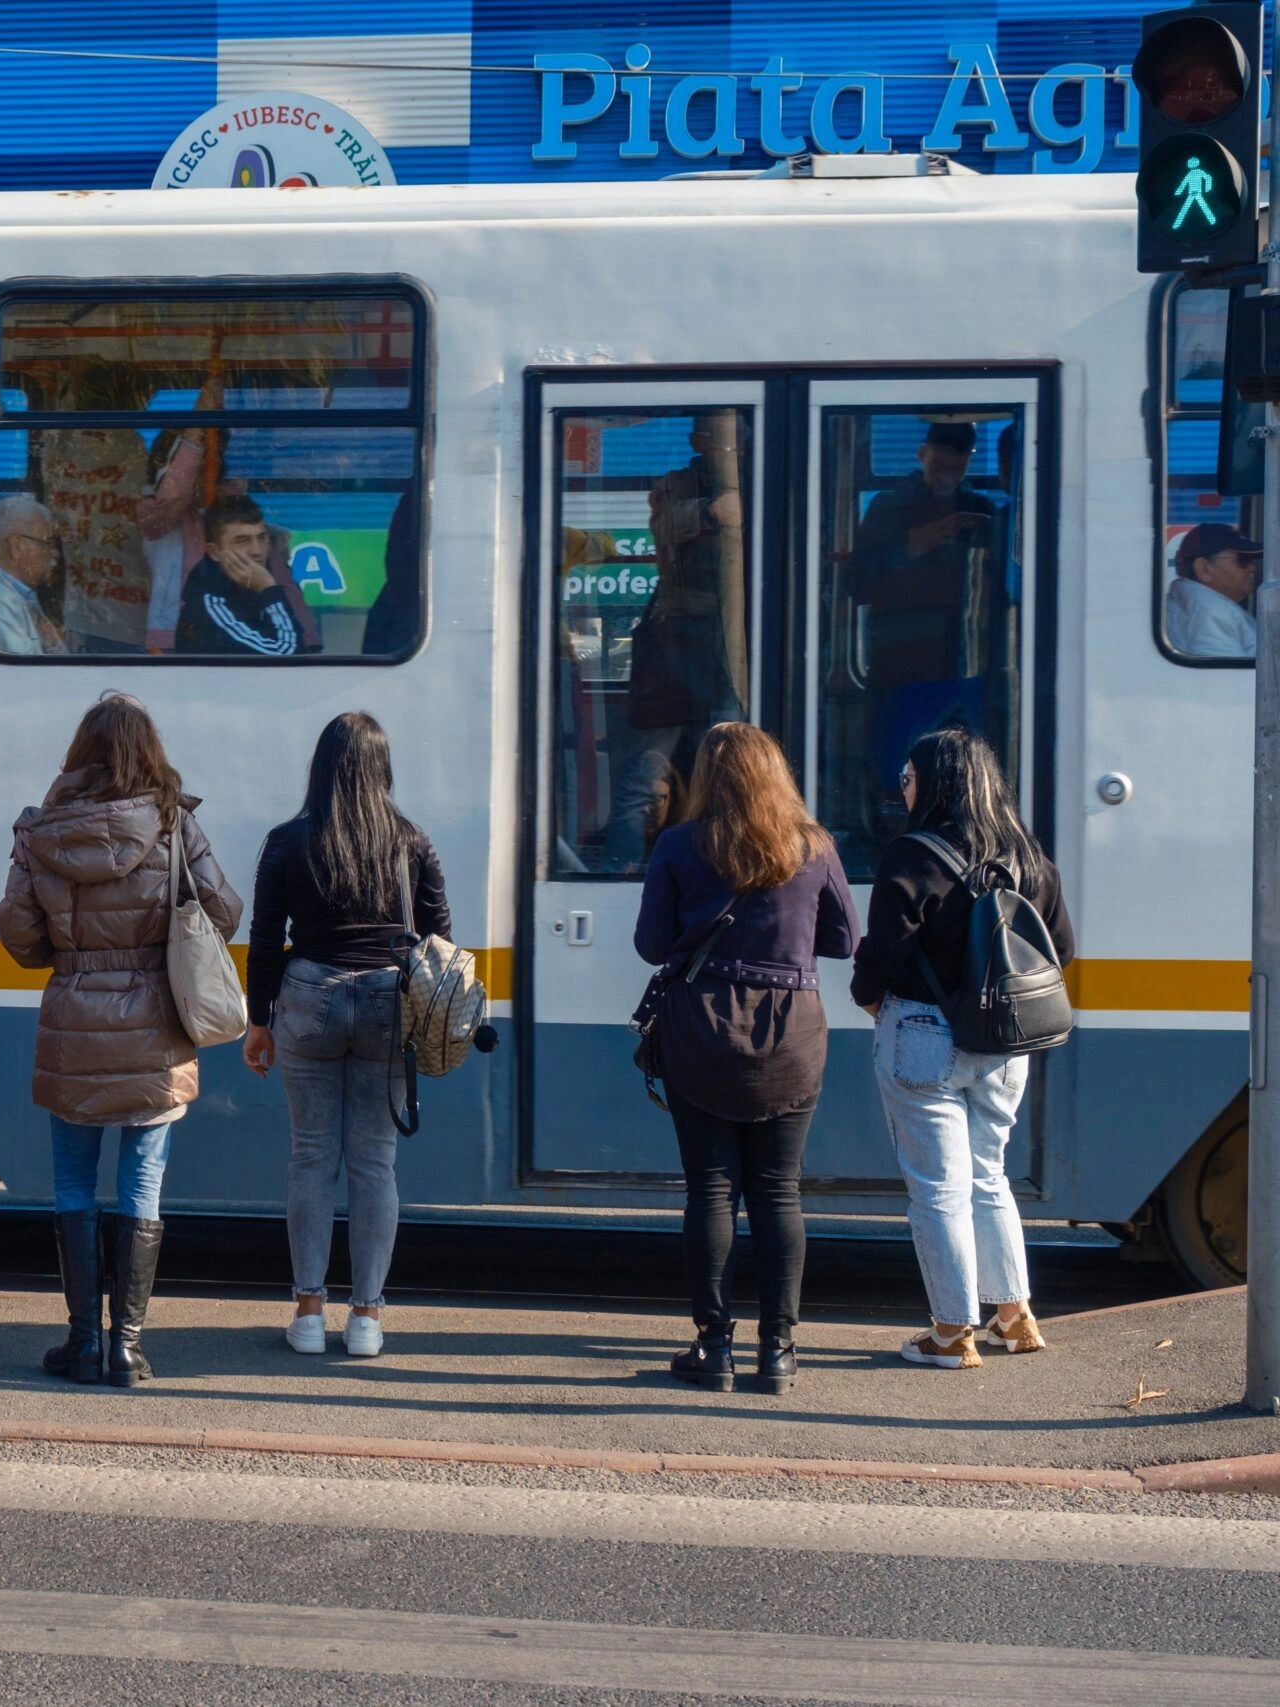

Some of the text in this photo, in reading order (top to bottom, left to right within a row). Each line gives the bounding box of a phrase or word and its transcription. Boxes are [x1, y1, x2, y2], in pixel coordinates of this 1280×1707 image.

[166, 129, 218, 189] CESC
[232, 105, 321, 131] IUBESC
[531, 43, 892, 160] Piata
